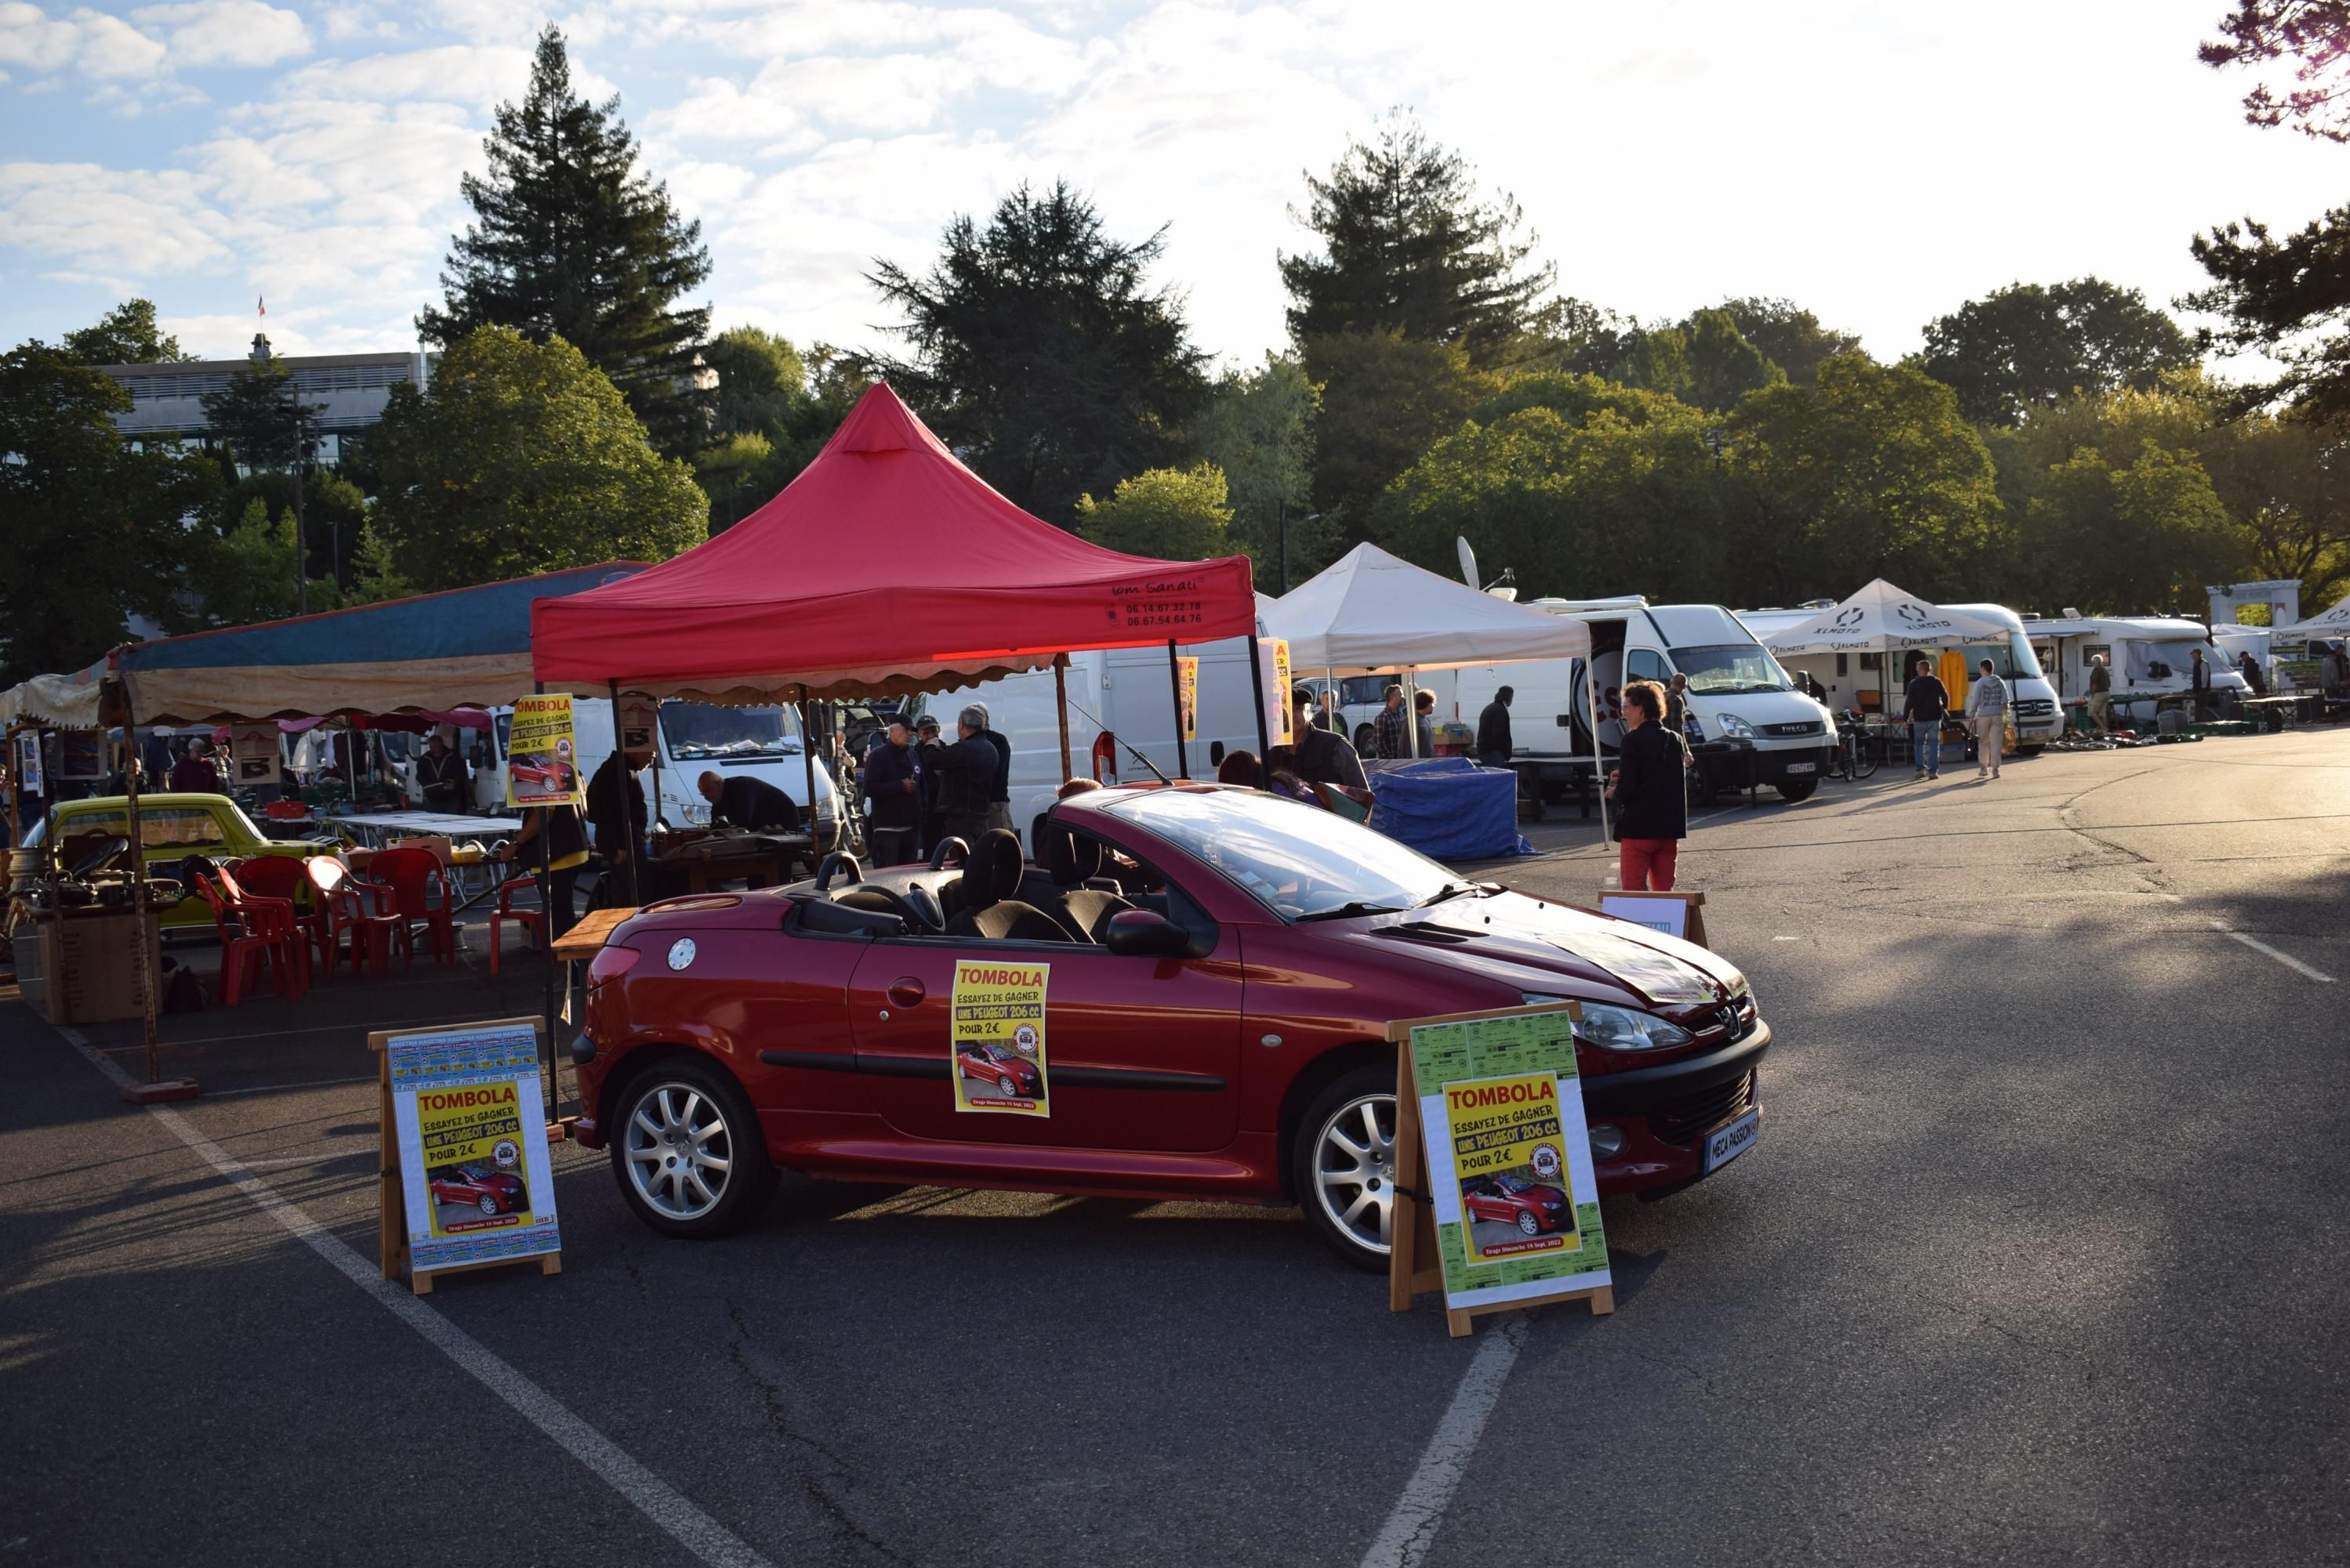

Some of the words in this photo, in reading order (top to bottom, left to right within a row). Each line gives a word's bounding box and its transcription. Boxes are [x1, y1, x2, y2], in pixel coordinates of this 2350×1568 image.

[1145, 580, 1198, 592] Sanati
[1126, 602, 1201, 614] 06.14.67.32.78
[1127, 614, 1202, 627] 06.67.54.64.76
[1904, 620, 1952, 630] XLMOTO
[516, 699, 571, 713] OMBOLA
[546, 713, 569, 722] GAGNER
[551, 725, 564, 733] 206
[511, 740, 529, 750] POUR
[530, 738, 544, 747] 2€
[959, 969, 1043, 987] TOMBOLA
[957, 994, 991, 1003] ESSAYEZ
[993, 994, 1003, 1002] DE
[1005, 992, 1039, 1001] GAGNER
[958, 1009, 972, 1020] UNE
[973, 1006, 1009, 1019] PEUGEOT
[1010, 1006, 1027, 1017] 206
[1028, 1006, 1039, 1017] CC
[959, 1023, 983, 1034] POUR
[985, 1023, 1000, 1034] 2€
[419, 1087, 516, 1111] TOMBOLA
[1449, 1081, 1554, 1110] TOMBOLA
[423, 1116, 462, 1132] ESSAYEZ
[464, 1114, 476, 1127] DE
[477, 1106, 515, 1124] GAGNER
[1454, 1116, 1496, 1135] ESSAYEZ
[1499, 1114, 1510, 1126] DE
[1513, 1105, 1554, 1123] GAGNER
[426, 1133, 444, 1149] UNE
[444, 1126, 484, 1146] PEUGEOT
[484, 1122, 503, 1136] 206
[503, 1119, 517, 1133] CC
[1457, 1138, 1475, 1154] UNE
[1476, 1128, 1519, 1151] PEUGEOT
[1521, 1124, 1543, 1140] 206
[1544, 1122, 1558, 1135] CC
[1711, 1135, 1728, 1161] MECA
[1728, 1121, 1751, 1150] PASSION
[430, 1147, 456, 1161] POUR
[459, 1144, 477, 1157] 2€
[1461, 1154, 1491, 1171] POUR
[1494, 1148, 1513, 1163] 2€
[1486, 1247, 1501, 1255] Tirage
[1502, 1244, 1525, 1253] Dimanche
[1535, 1241, 1547, 1251] Sept.
[1547, 1239, 1561, 1248] 2022
